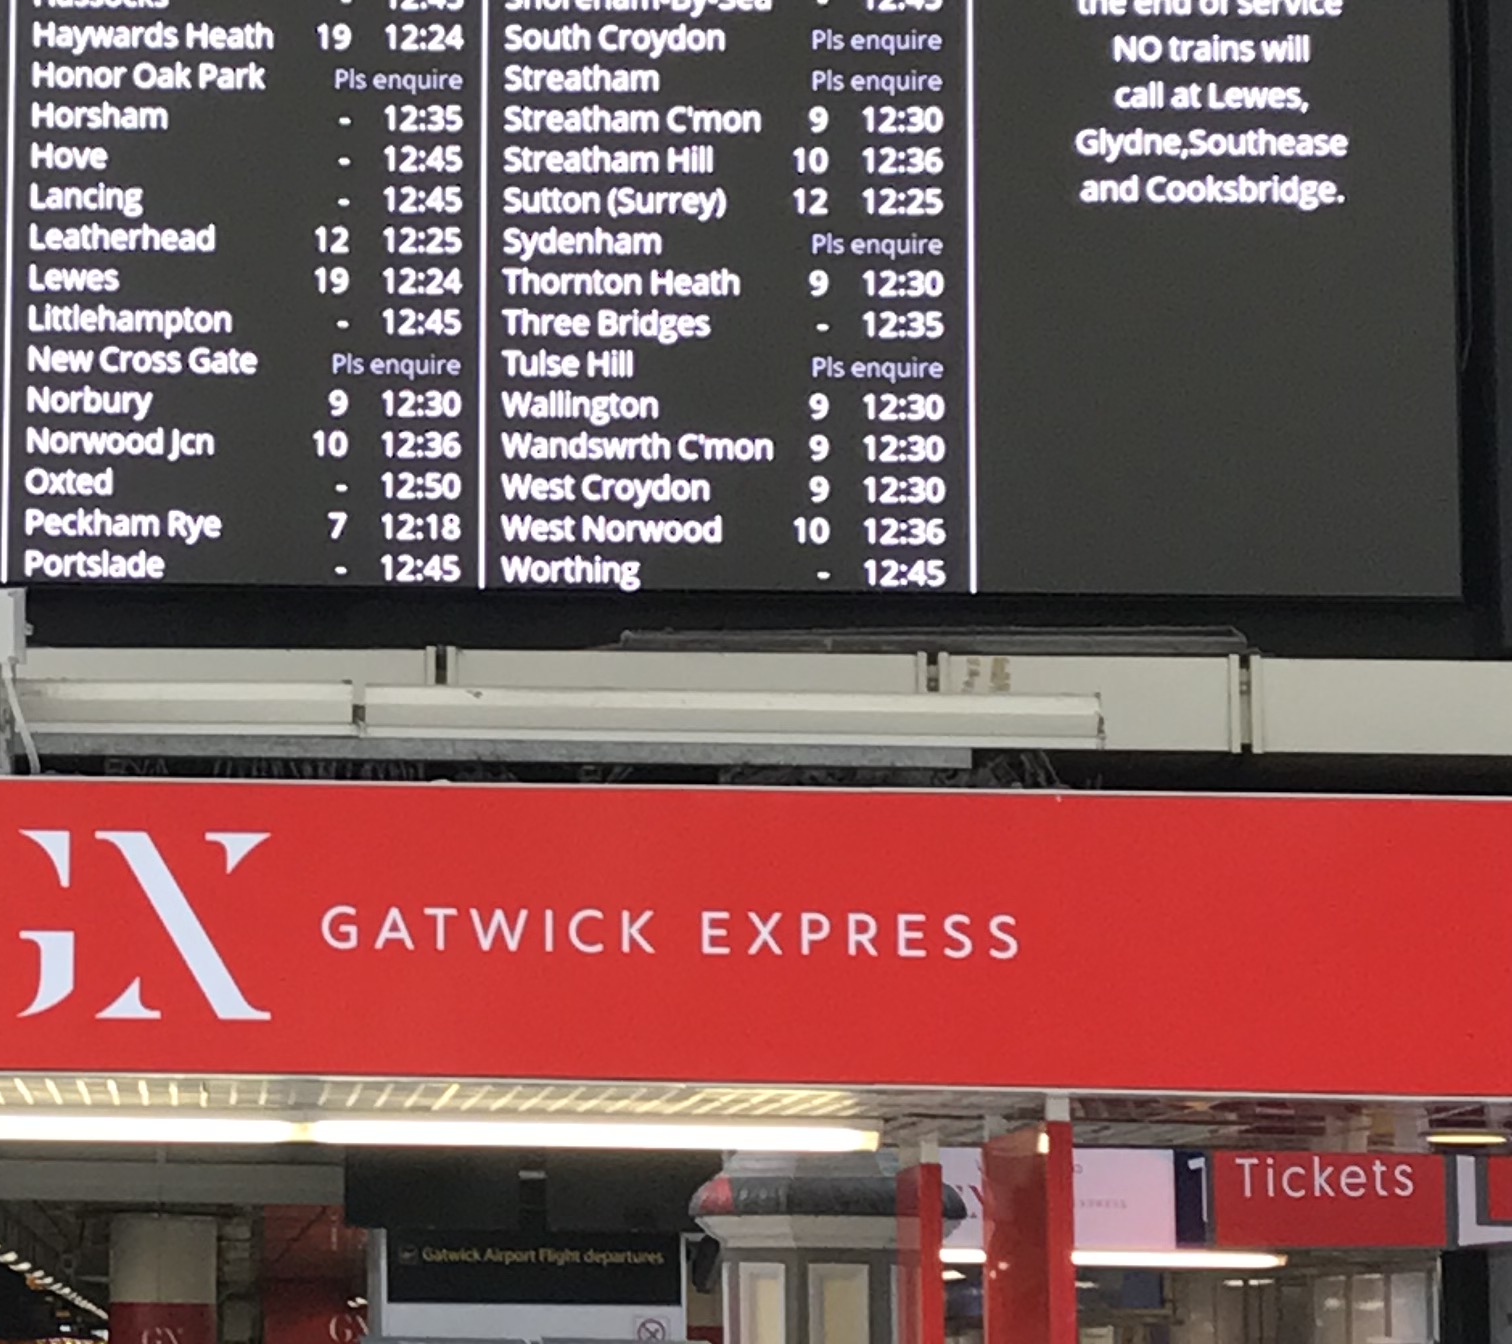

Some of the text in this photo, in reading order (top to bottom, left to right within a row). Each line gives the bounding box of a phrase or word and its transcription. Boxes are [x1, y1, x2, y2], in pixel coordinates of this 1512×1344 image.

[1113, 34, 1309, 62] NO trains will
[1114, 81, 1309, 113] call at Lewes,
[1080, 175, 1345, 210] and Cooksbridge.
[30, 223, 462, 254] Leatherhead 12:25
[502, 267, 740, 296] Thornton Heath
[28, 303, 232, 339] Littlehampton
[501, 431, 773, 461] Wandswrth C'mon
[25, 508, 461, 545] Peckham Rye 7 12:18
[321, 906, 1018, 959] GATWICK EXPRESS
[1235, 1157, 1415, 1198] Tickets
[422, 1247, 664, 1267] Gatwick Airport Flight departures
